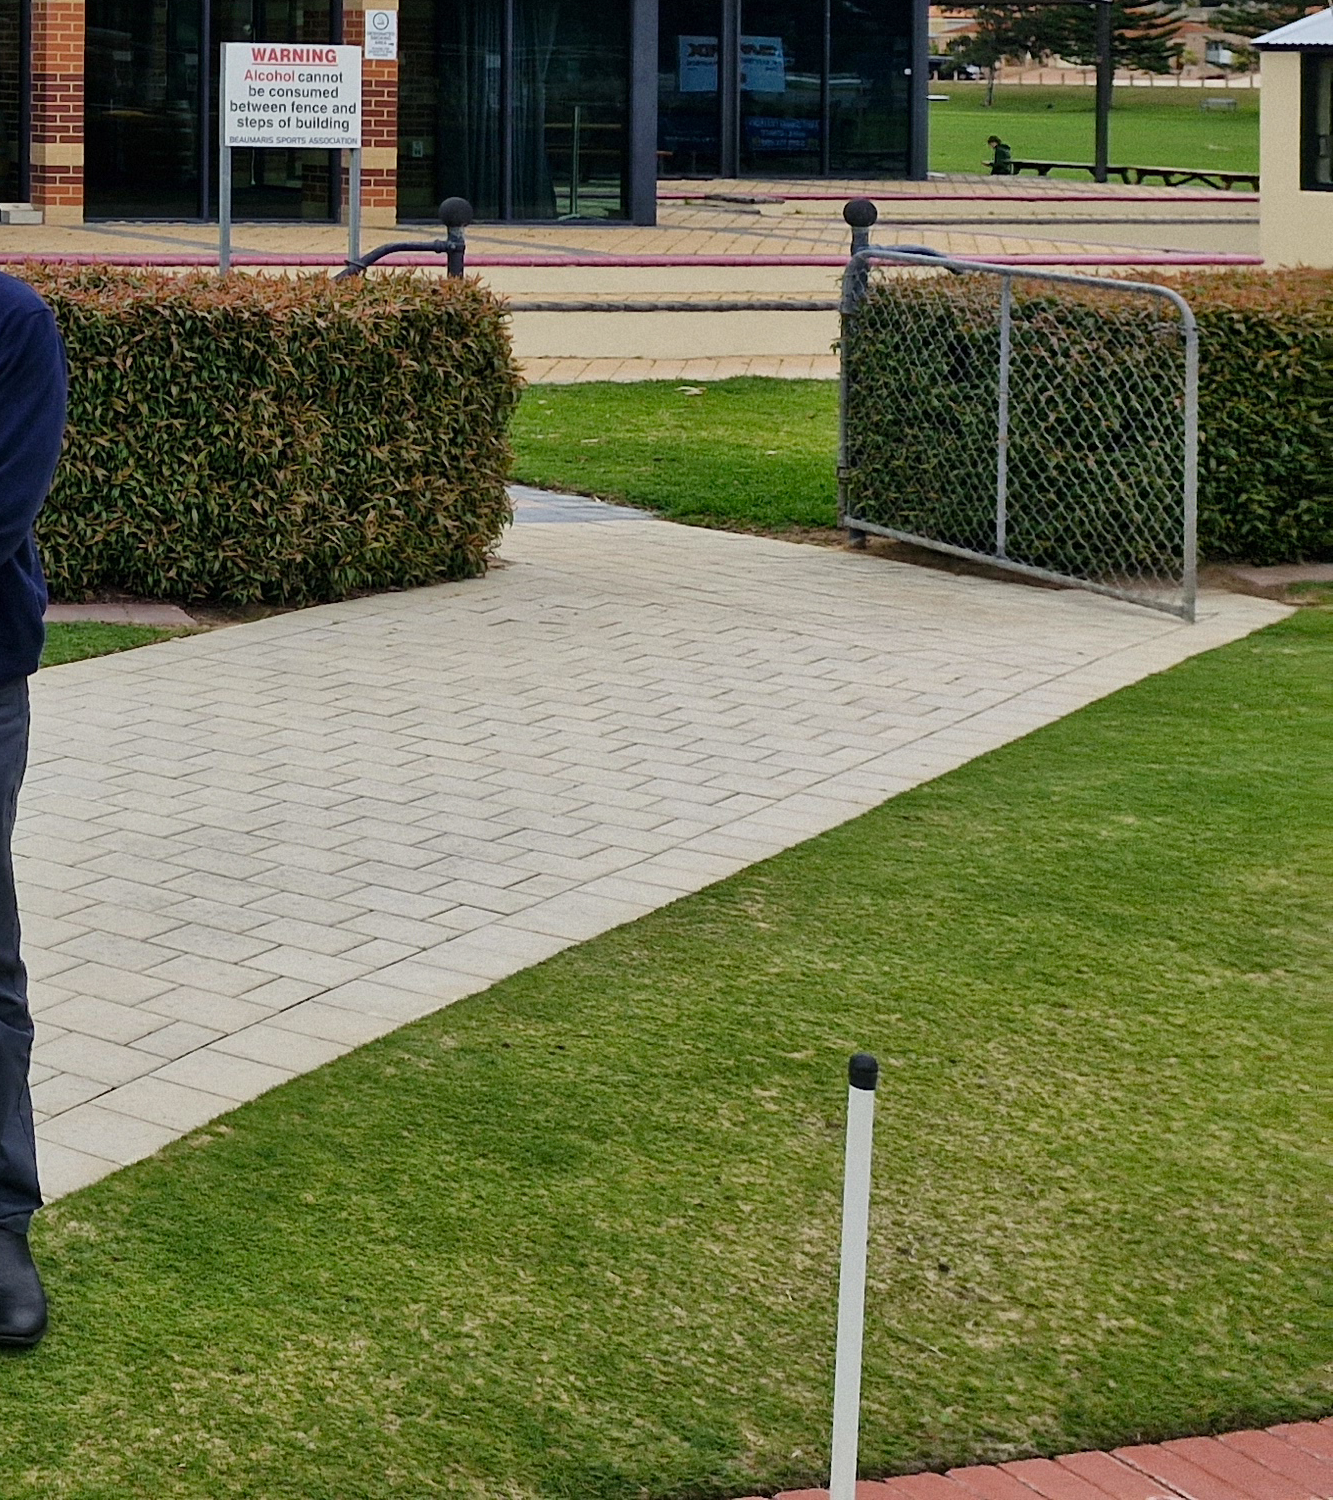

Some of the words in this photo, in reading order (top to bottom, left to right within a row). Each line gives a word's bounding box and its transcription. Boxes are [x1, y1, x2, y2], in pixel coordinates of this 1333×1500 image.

[251, 47, 338, 63] WARNING
[244, 69, 295, 82] Alcohol
[298, 72, 343, 83] cannot
[248, 85, 265, 97] be
[269, 86, 339, 99] consumed
[230, 100, 287, 113] between
[291, 101, 328, 114] fence
[332, 102, 357, 114] and
[237, 116, 274, 131] steps
[278, 117, 291, 128] of
[296, 117, 350, 132] building
[229, 136, 274, 144] BEAUMARIS
[276, 136, 306, 144] SPORTS
[308, 136, 358, 145] ASSOCIATION
